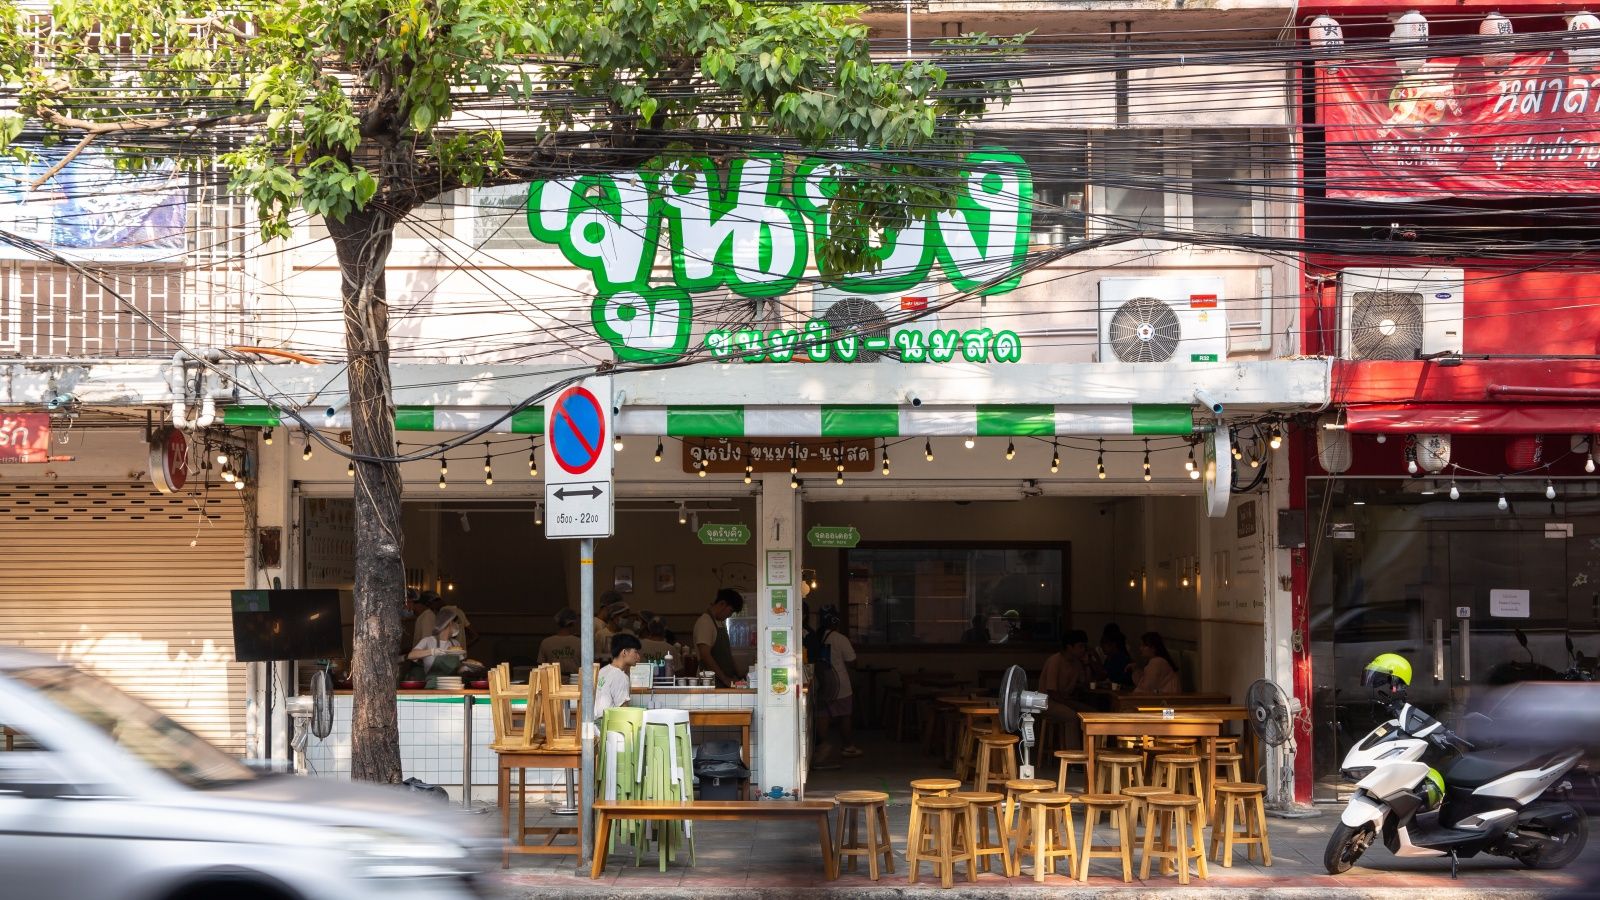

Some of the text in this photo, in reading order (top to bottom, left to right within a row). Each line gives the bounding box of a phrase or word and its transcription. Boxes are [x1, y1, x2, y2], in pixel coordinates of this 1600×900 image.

[530, 147, 1033, 363] จูนปง
[556, 513, 573, 524] 0500
[580, 512, 599, 524] 2200
